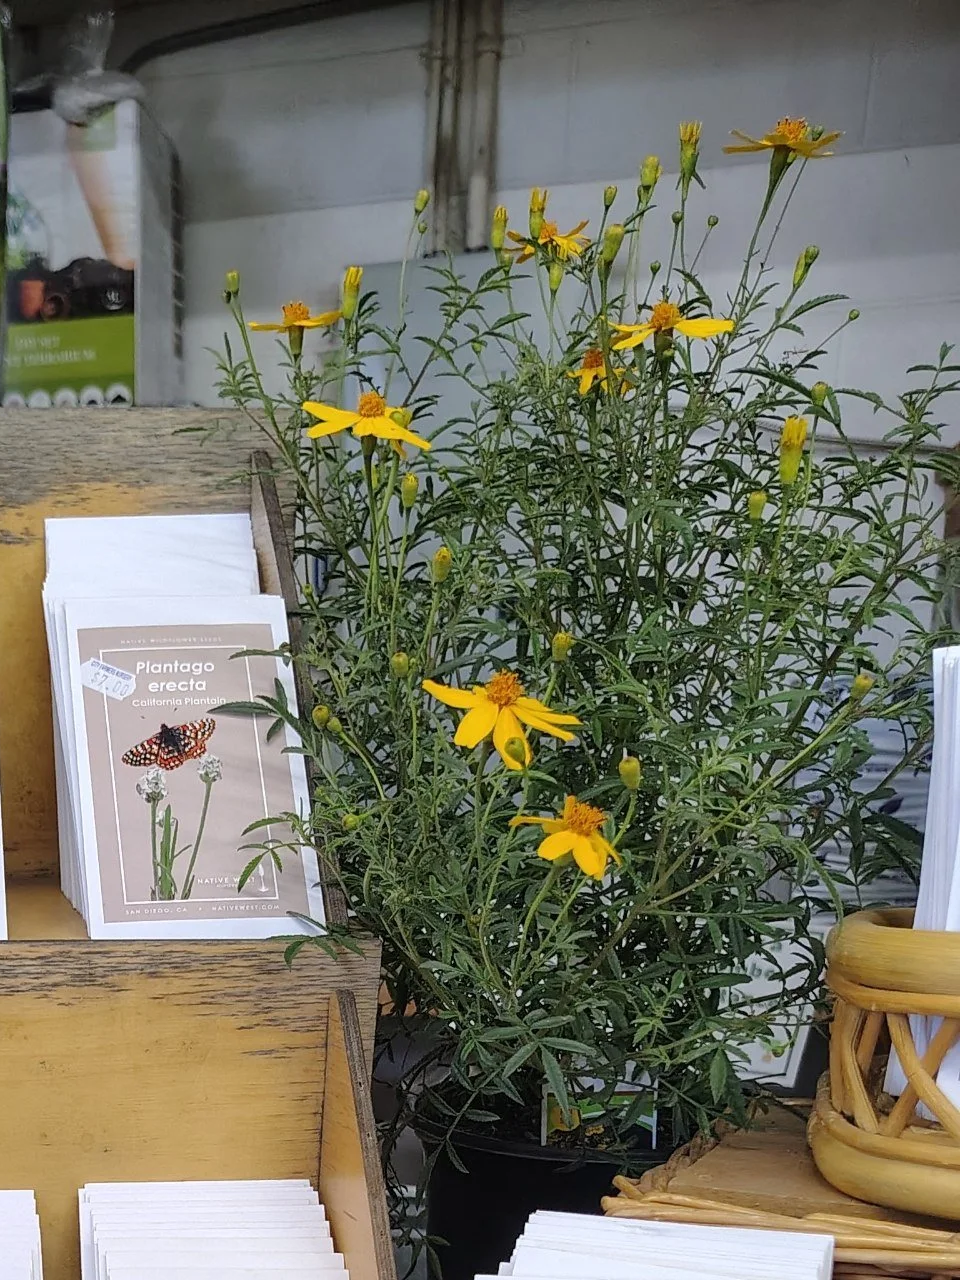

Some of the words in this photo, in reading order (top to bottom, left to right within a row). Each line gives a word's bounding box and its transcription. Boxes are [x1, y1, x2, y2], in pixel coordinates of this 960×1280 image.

[136, 660, 215, 675] Plantago
[148, 679, 207, 692] erecta
[132, 698, 183, 707] California
[185, 696, 226, 706] Plantain
[197, 877, 229, 885] NATIVE
[212, 904, 280, 912] NATIVEWEST.COM
